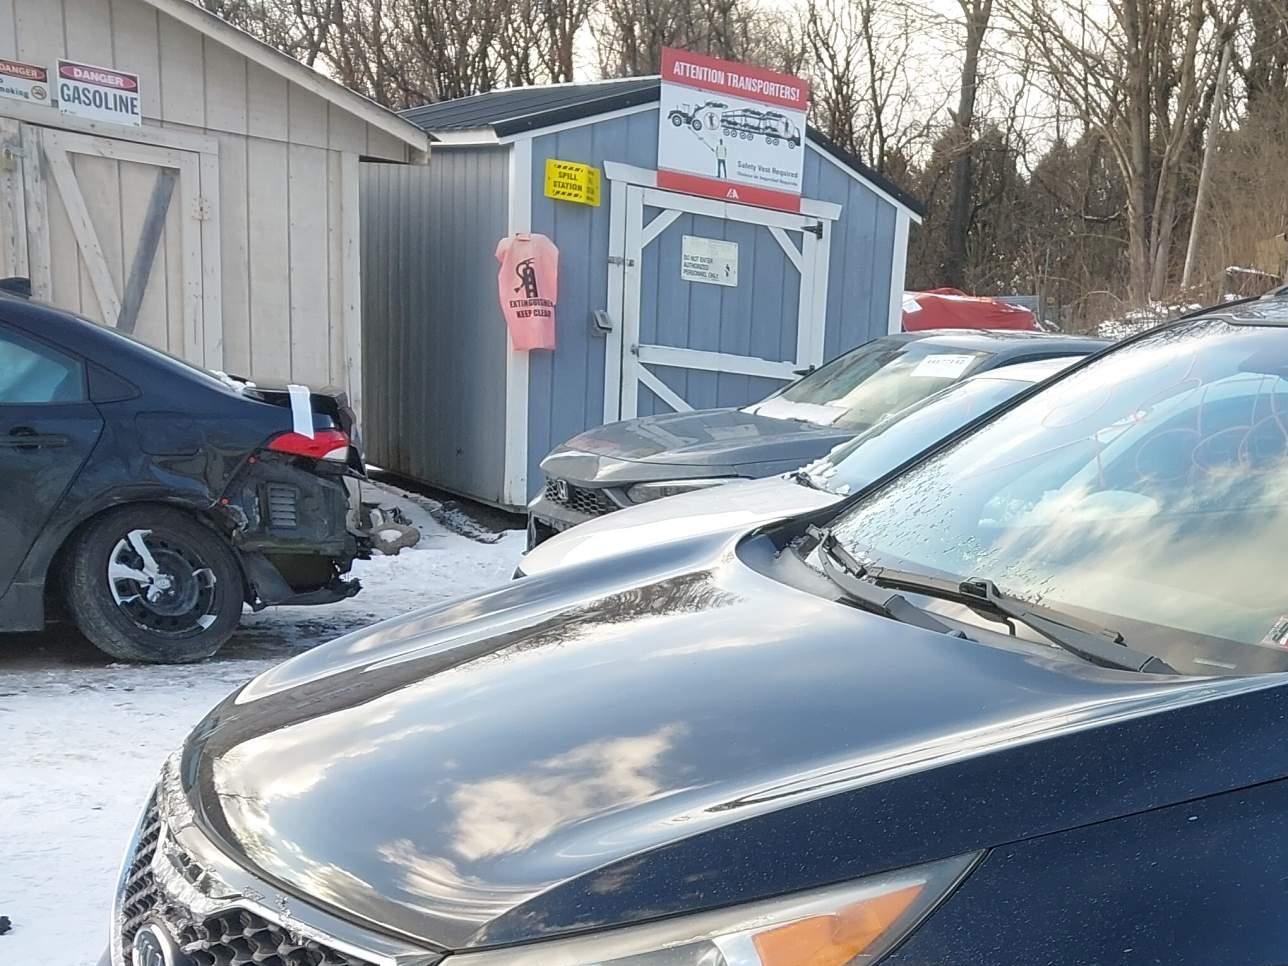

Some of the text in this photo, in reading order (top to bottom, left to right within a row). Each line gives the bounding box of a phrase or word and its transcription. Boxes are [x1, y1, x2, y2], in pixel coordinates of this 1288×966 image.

[73, 67, 124, 87] DANGER
[673, 61, 801, 102] ATTENTION TRANSPORTERS!
[60, 83, 140, 115] GASOLINE
[558, 171, 577, 180] SPILL
[737, 160, 757, 172] Safety
[772, 167, 799, 178] Required
[552, 180, 583, 191] STATION
[516, 309, 551, 318] KEEP CLEAR
